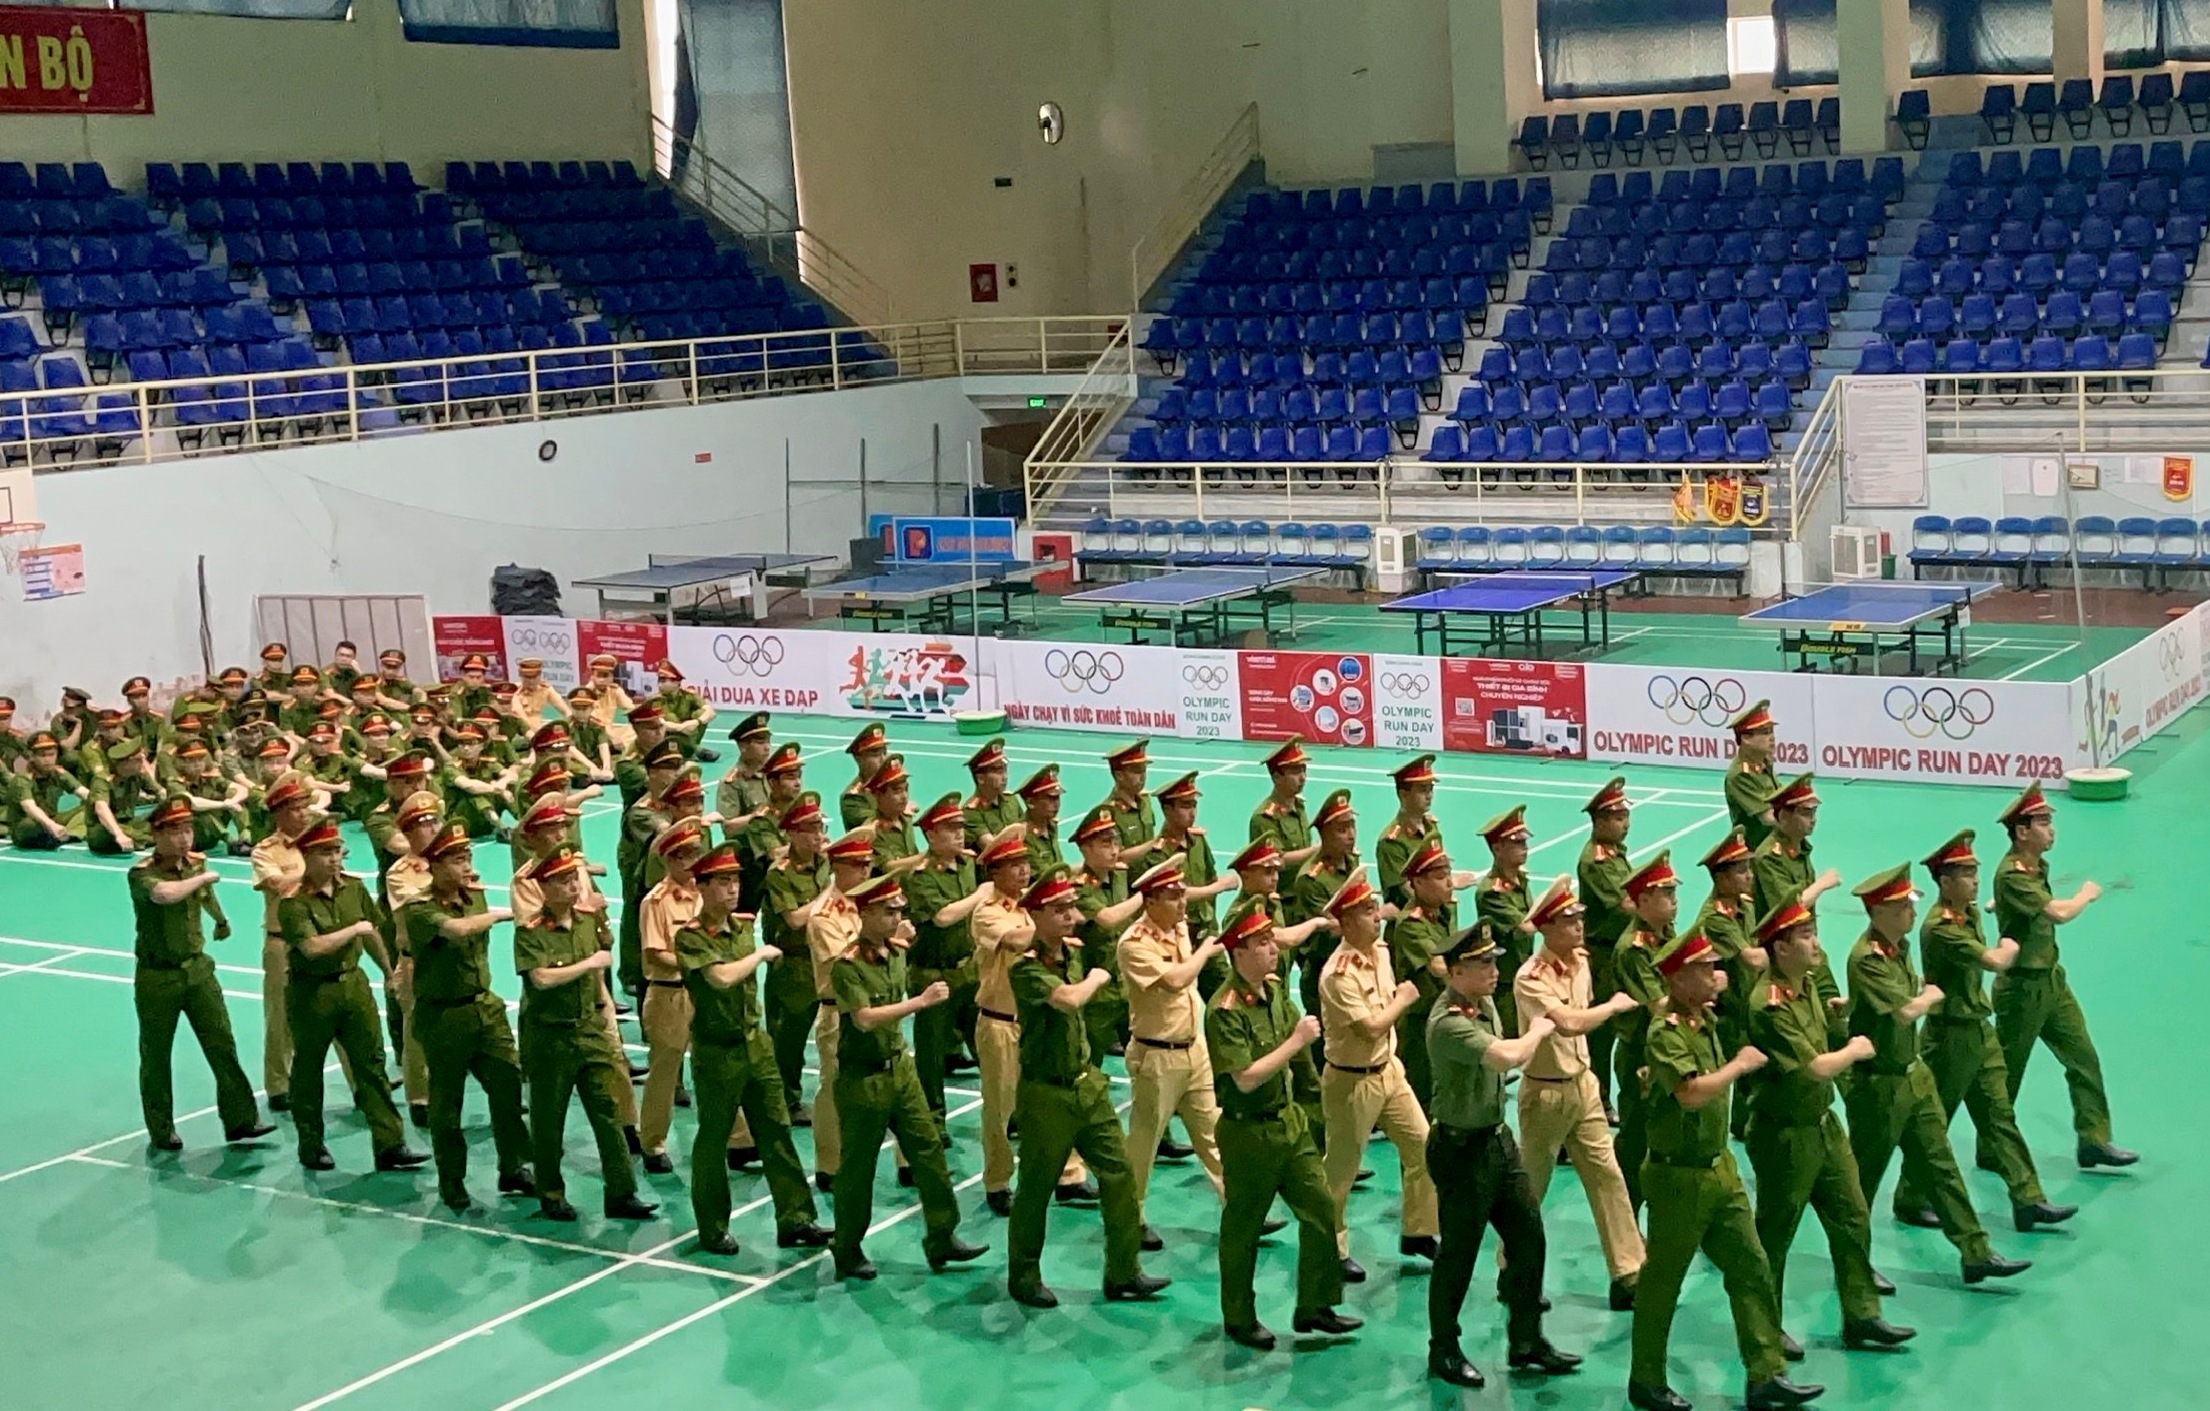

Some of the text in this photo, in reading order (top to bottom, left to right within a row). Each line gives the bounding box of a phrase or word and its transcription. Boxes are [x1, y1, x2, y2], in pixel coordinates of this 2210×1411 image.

[37, 25, 94, 103] BỘ
[760, 687, 780, 706] XE
[1183, 696, 1230, 709] OLYMPIC
[1033, 704, 1058, 725] CHẠY
[1124, 707, 1152, 727] TOÀN
[1154, 709, 1176, 729] DÂN
[1185, 711, 1232, 723] RUN DAY
[1381, 705, 1432, 719] OLYMPIC
[1196, 726, 1220, 737] 2023
[1384, 720, 1408, 732] RUN
[1411, 722, 1435, 733] DAY
[1395, 735, 1421, 747] 2023
[1594, 731, 1674, 756] OLYMPIC
[1678, 736, 1719, 759] RUN
[1773, 742, 1809, 764] 023
[1822, 745, 2064, 780] OLYMPIC RUN DAY 2023
